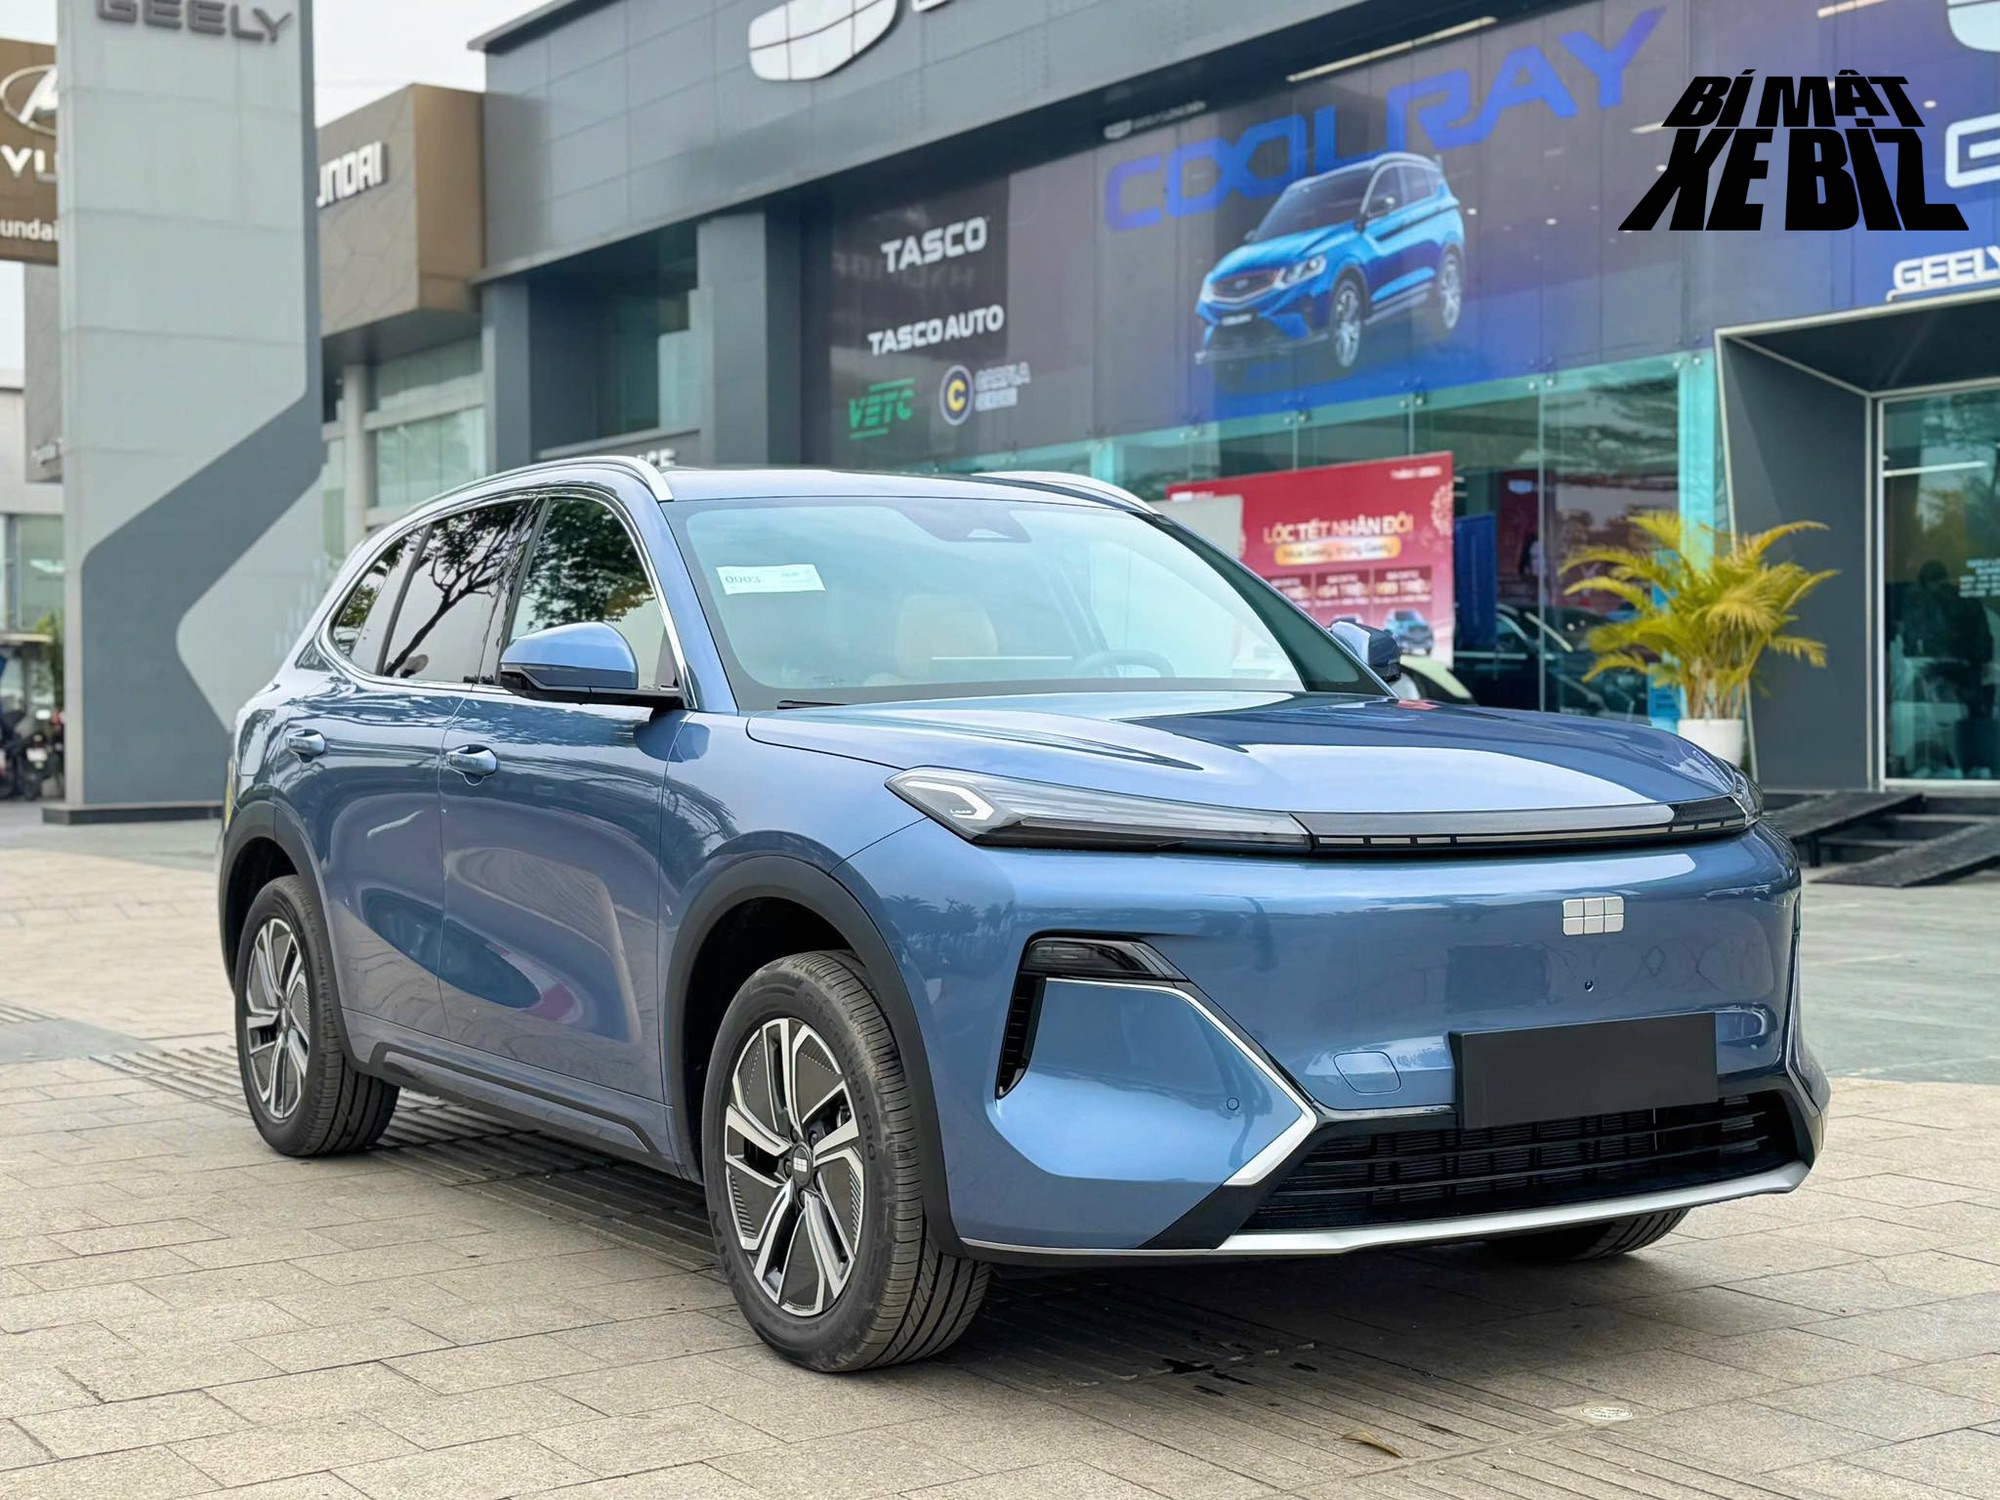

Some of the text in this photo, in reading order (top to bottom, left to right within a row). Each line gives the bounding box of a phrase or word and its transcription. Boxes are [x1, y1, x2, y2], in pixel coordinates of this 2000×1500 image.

[96, 0, 292, 44] GEELY
[881, 217, 988, 273] TASCO
[867, 304, 1004, 355] TASCO AUTO
[848, 389, 916, 428] VETC
